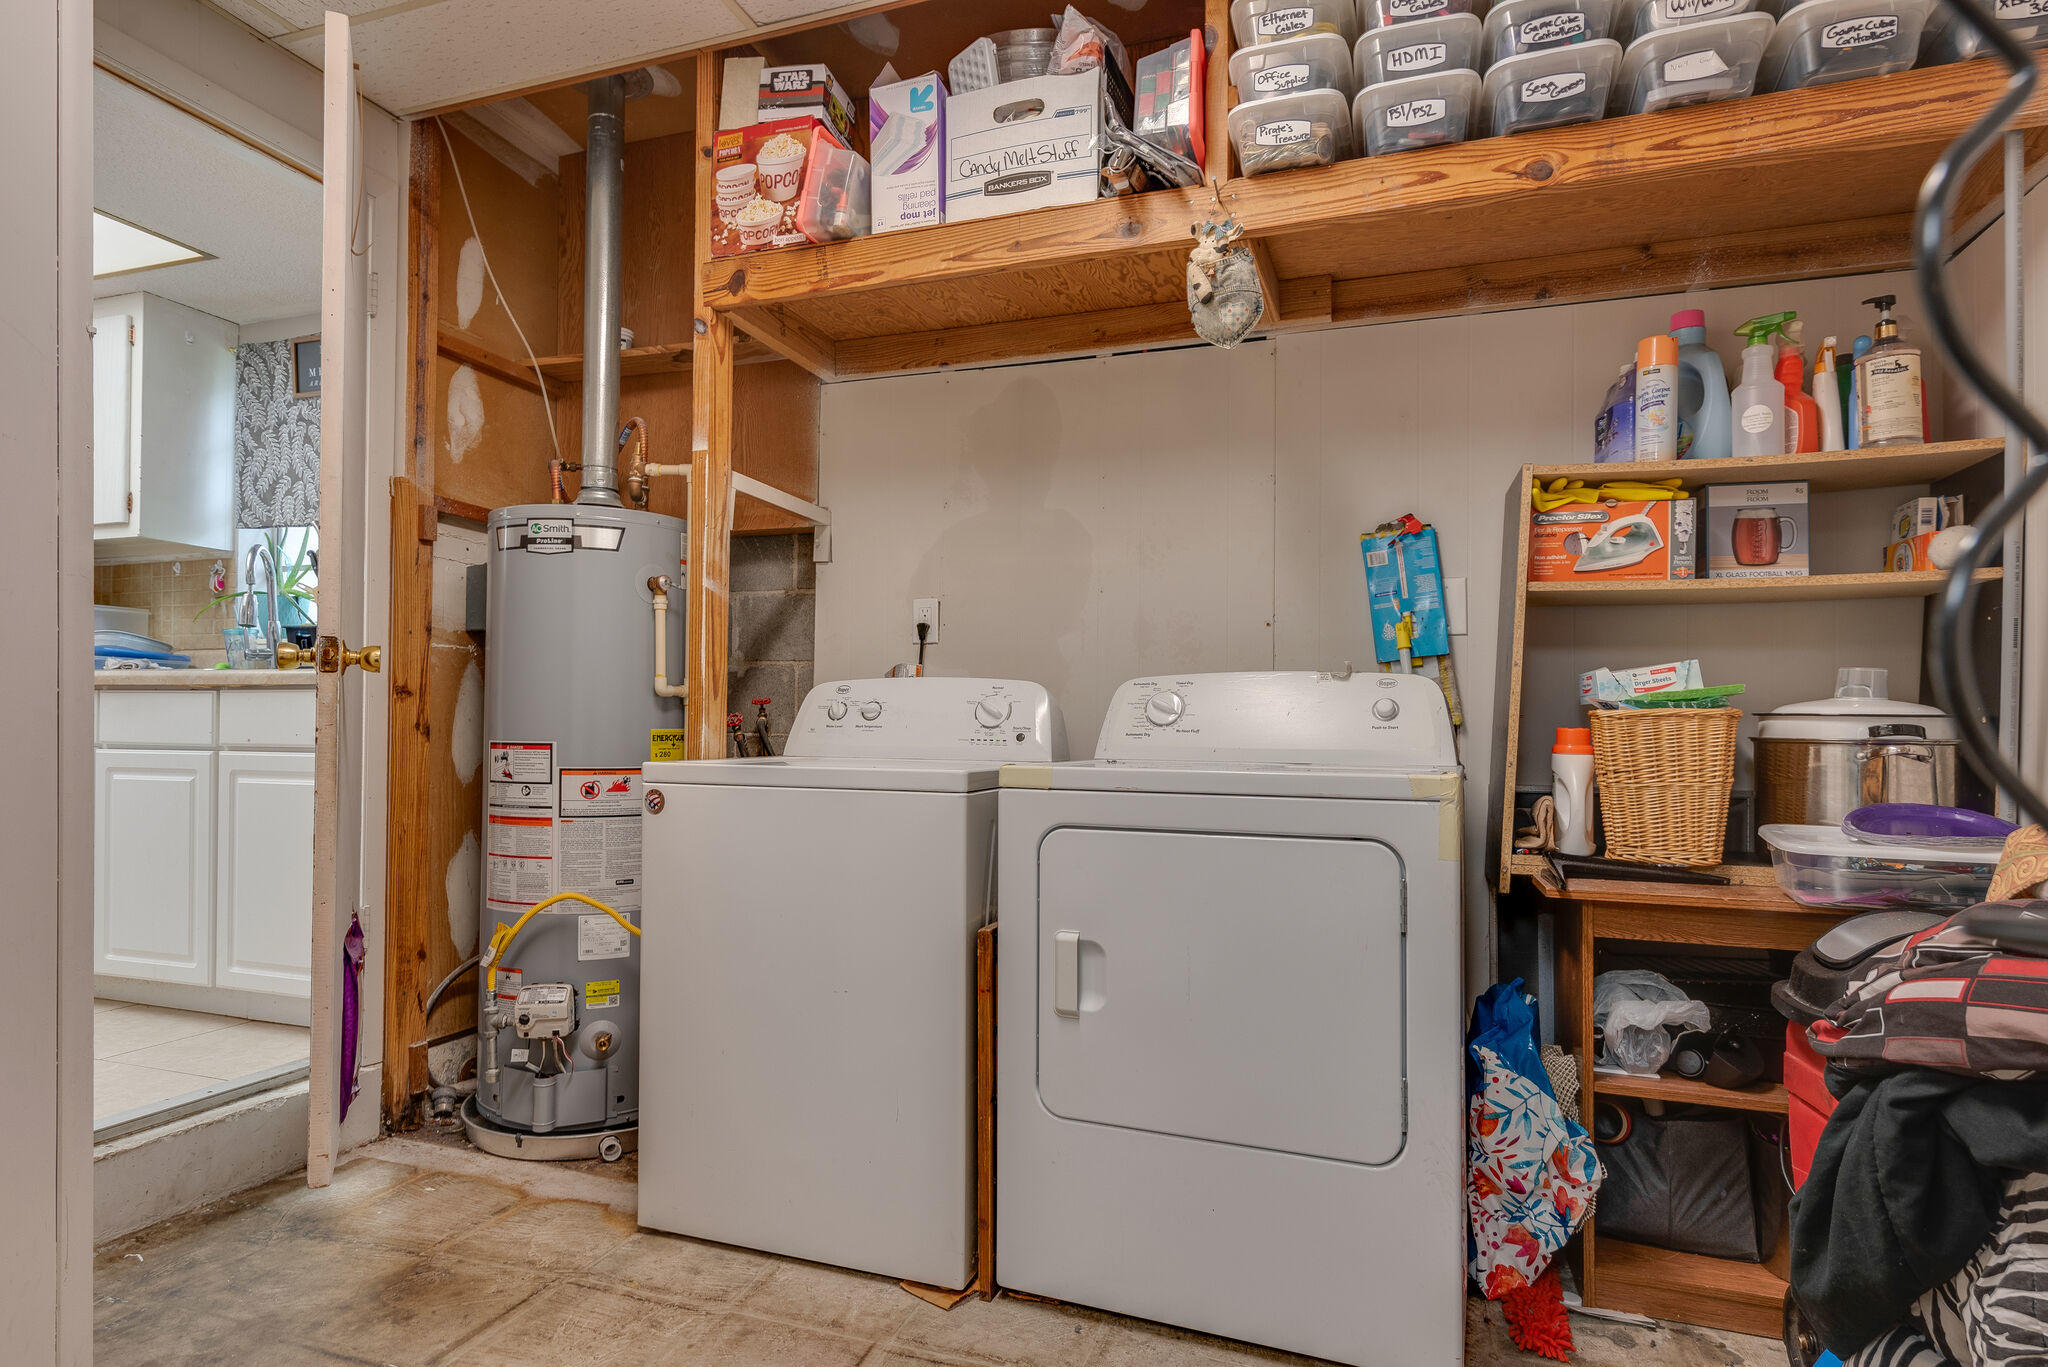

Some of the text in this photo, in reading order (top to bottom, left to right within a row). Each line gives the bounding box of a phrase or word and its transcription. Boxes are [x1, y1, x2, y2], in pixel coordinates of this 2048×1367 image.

[1262, 10, 1308, 27] Ethernet
[1524, 15, 1580, 34] Game Cube
[1275, 22, 1305, 34] Cables
[1532, 25, 1582, 41] Controllers
[1827, 18, 1896, 39] Game Cube
[1836, 28, 1896, 46] Controllers
[1391, 46, 1443, 67] HDMI
[776, 71, 808, 82] STAR
[1257, 71, 1291, 85] Office
[1274, 75, 1310, 91] Supplies
[773, 80, 810, 92] WARS
[1526, 81, 1558, 97] Sega
[1388, 102, 1438, 121] PS1/PS2
[1260, 123, 1293, 137] Pirate's
[1003, 147, 1037, 171] Melt
[1037, 140, 1080, 163] Stuff
[988, 175, 1048, 191] BANKERS BOX
[897, 189, 936, 201] pad refills
[902, 200, 936, 211] cleaning
[900, 208, 936, 221] jet mop
[1537, 513, 1603, 522] Proctor Silex
[543, 524, 570, 533] Smith
[1634, 676, 1672, 687] Dryer Sheets
